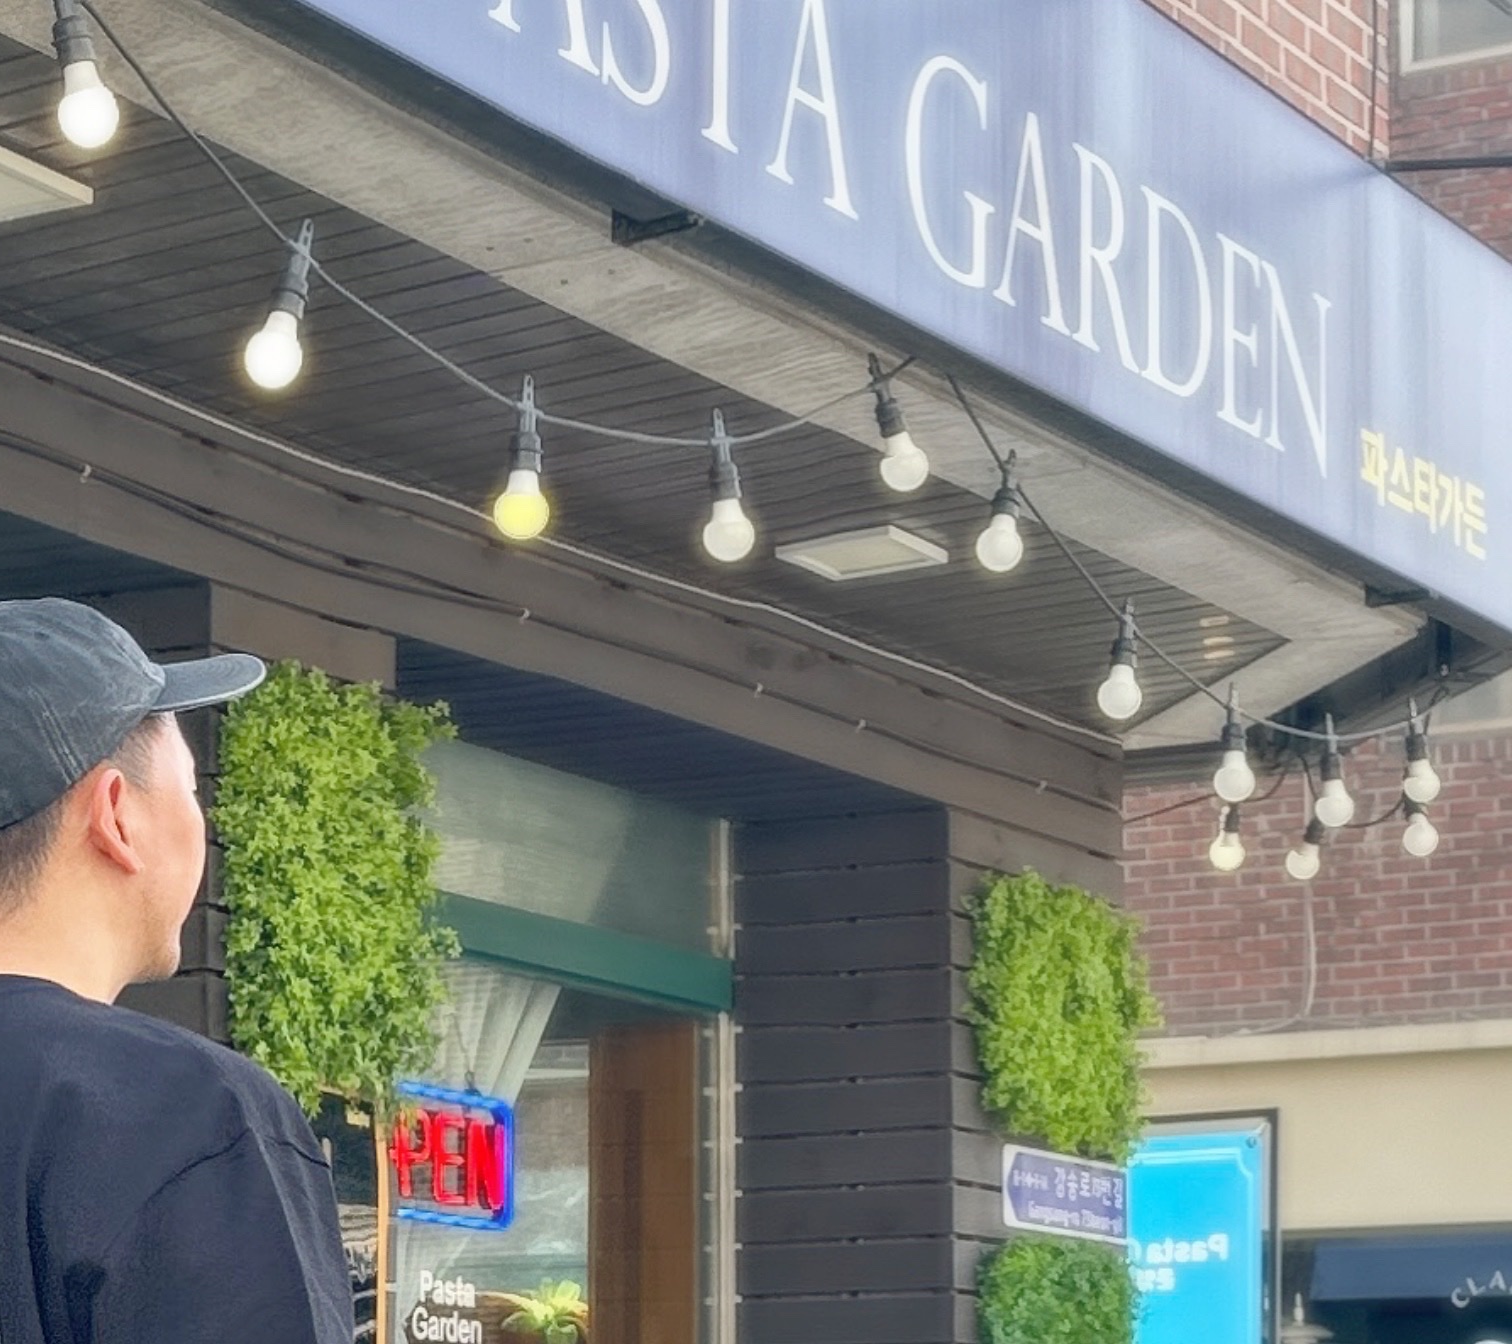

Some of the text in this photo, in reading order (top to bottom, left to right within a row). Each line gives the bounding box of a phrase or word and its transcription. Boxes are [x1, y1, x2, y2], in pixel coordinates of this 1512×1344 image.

[904, 55, 1332, 480] GARDEN
[1360, 428, 1488, 561] 파스타가든
[389, 1108, 505, 1211] PEN
[420, 1269, 476, 1308] Pasta
[1451, 1270, 1512, 1308] CLA
